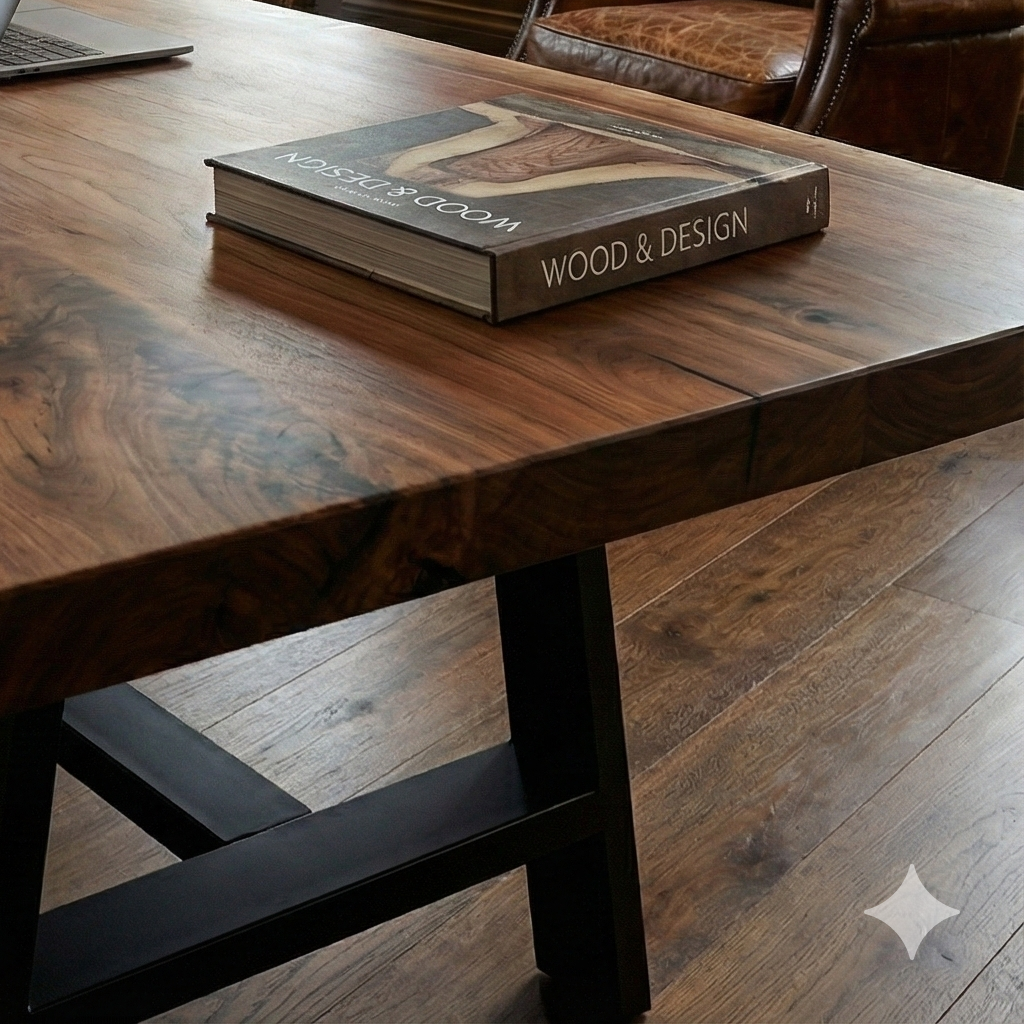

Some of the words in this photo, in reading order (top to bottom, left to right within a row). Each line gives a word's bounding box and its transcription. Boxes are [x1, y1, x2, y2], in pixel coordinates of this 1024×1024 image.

[274, 151, 392, 191] DESIGN
[386, 185, 418, 197] &
[413, 195, 522, 233] WOOD
[540, 240, 628, 288] WOOD
[635, 232, 654, 264] &
[660, 206, 749, 258] DESIGN
